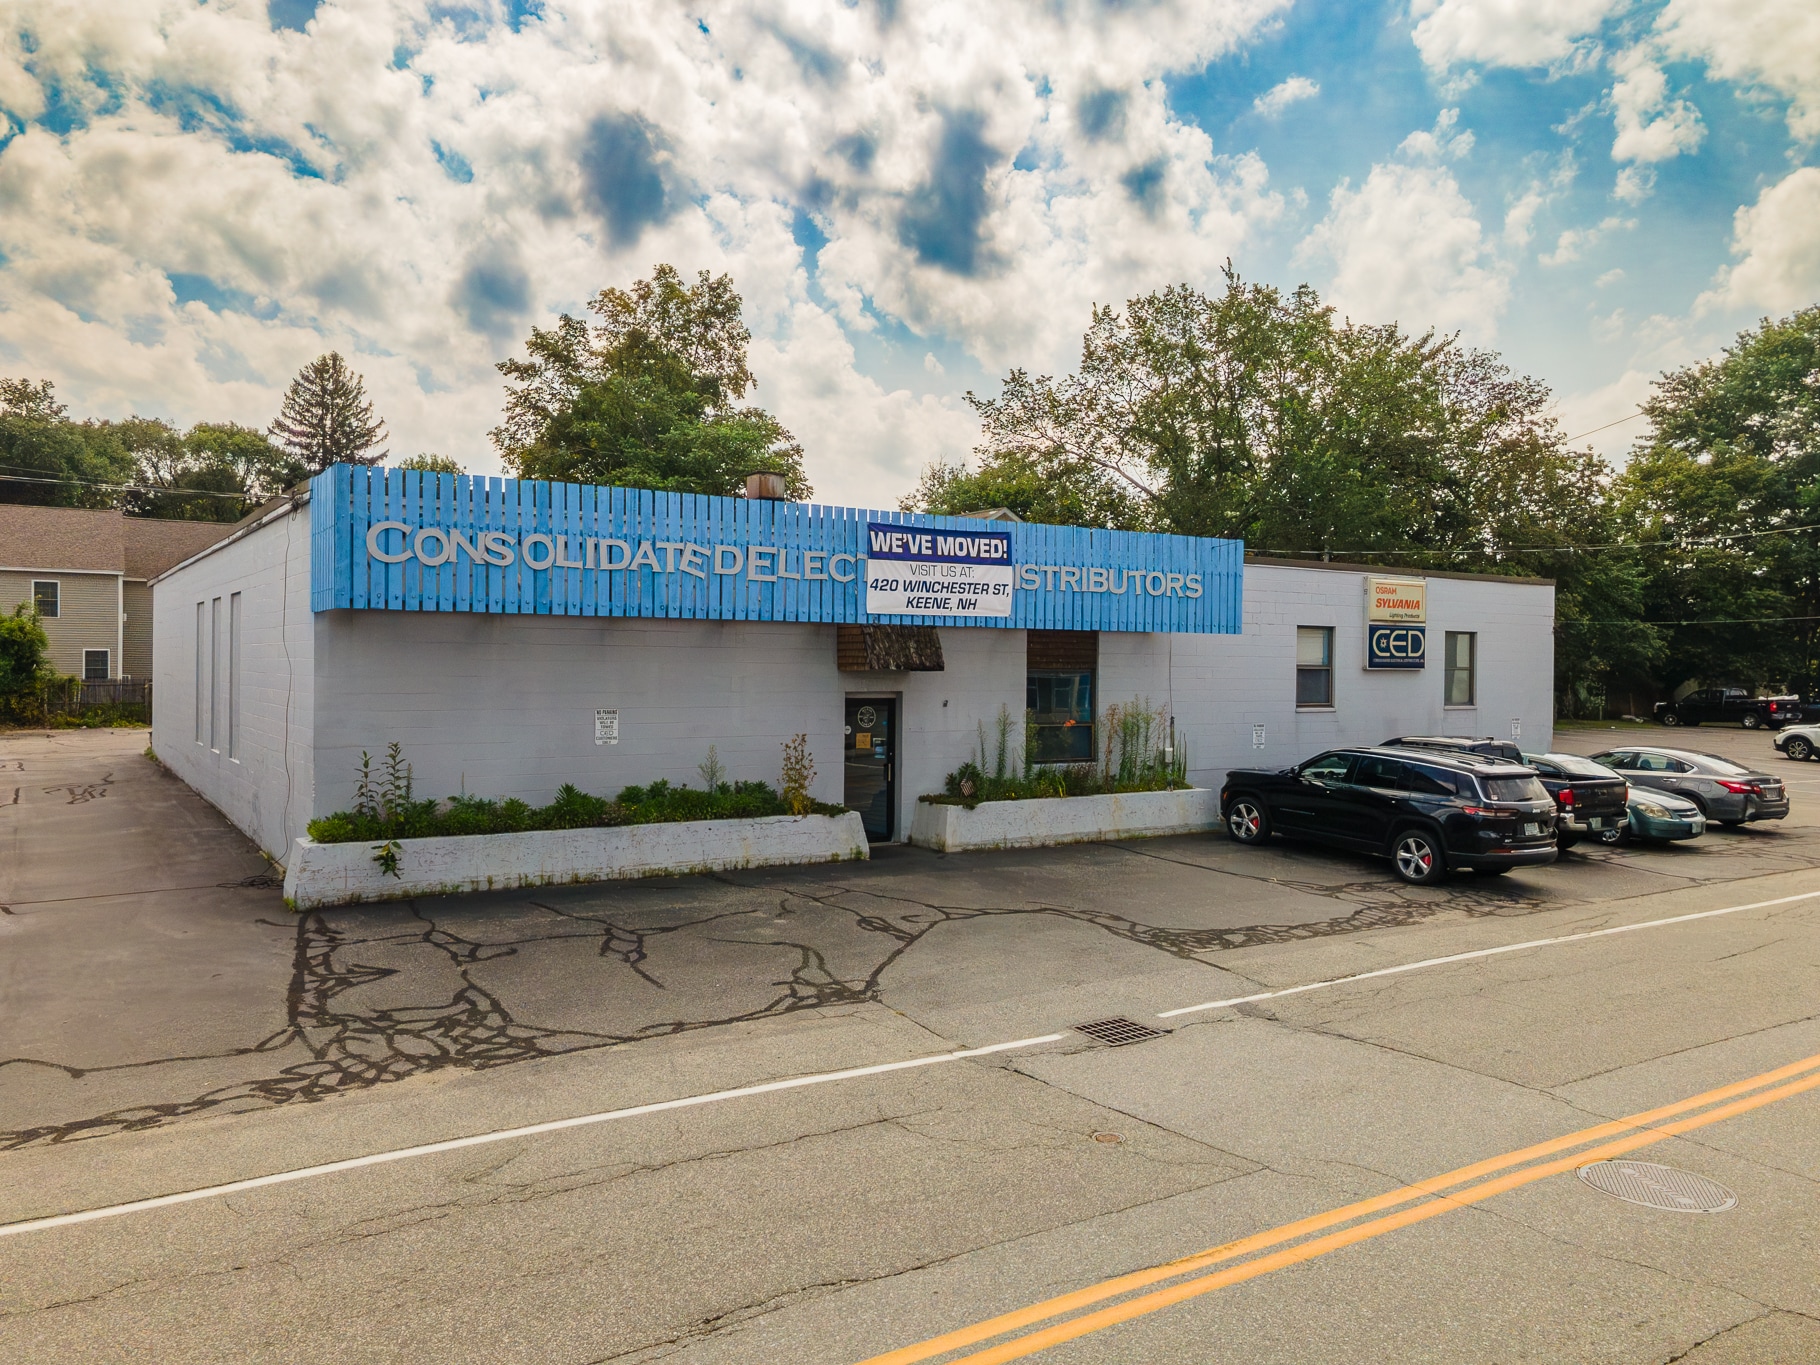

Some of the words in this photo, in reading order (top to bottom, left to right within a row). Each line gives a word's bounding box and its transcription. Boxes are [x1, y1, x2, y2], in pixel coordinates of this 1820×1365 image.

[870, 531, 932, 555] WE'VE
[937, 536, 1008, 559] MOVED!
[910, 564, 938, 577] VISIT
[941, 565, 957, 578] US
[959, 566, 975, 579] AT:
[870, 578, 899, 592] 420
[903, 580, 990, 595] WINCHESTER
[993, 584, 1010, 598] ST,
[1014, 563, 1203, 599] ISTRIBUTORS
[1376, 586, 1397, 595] OSRAM
[906, 596, 954, 612] KEENE,
[956, 598, 978, 611] NH
[1376, 598, 1420, 611] SYLVANIA
[1373, 630, 1424, 657] CED
